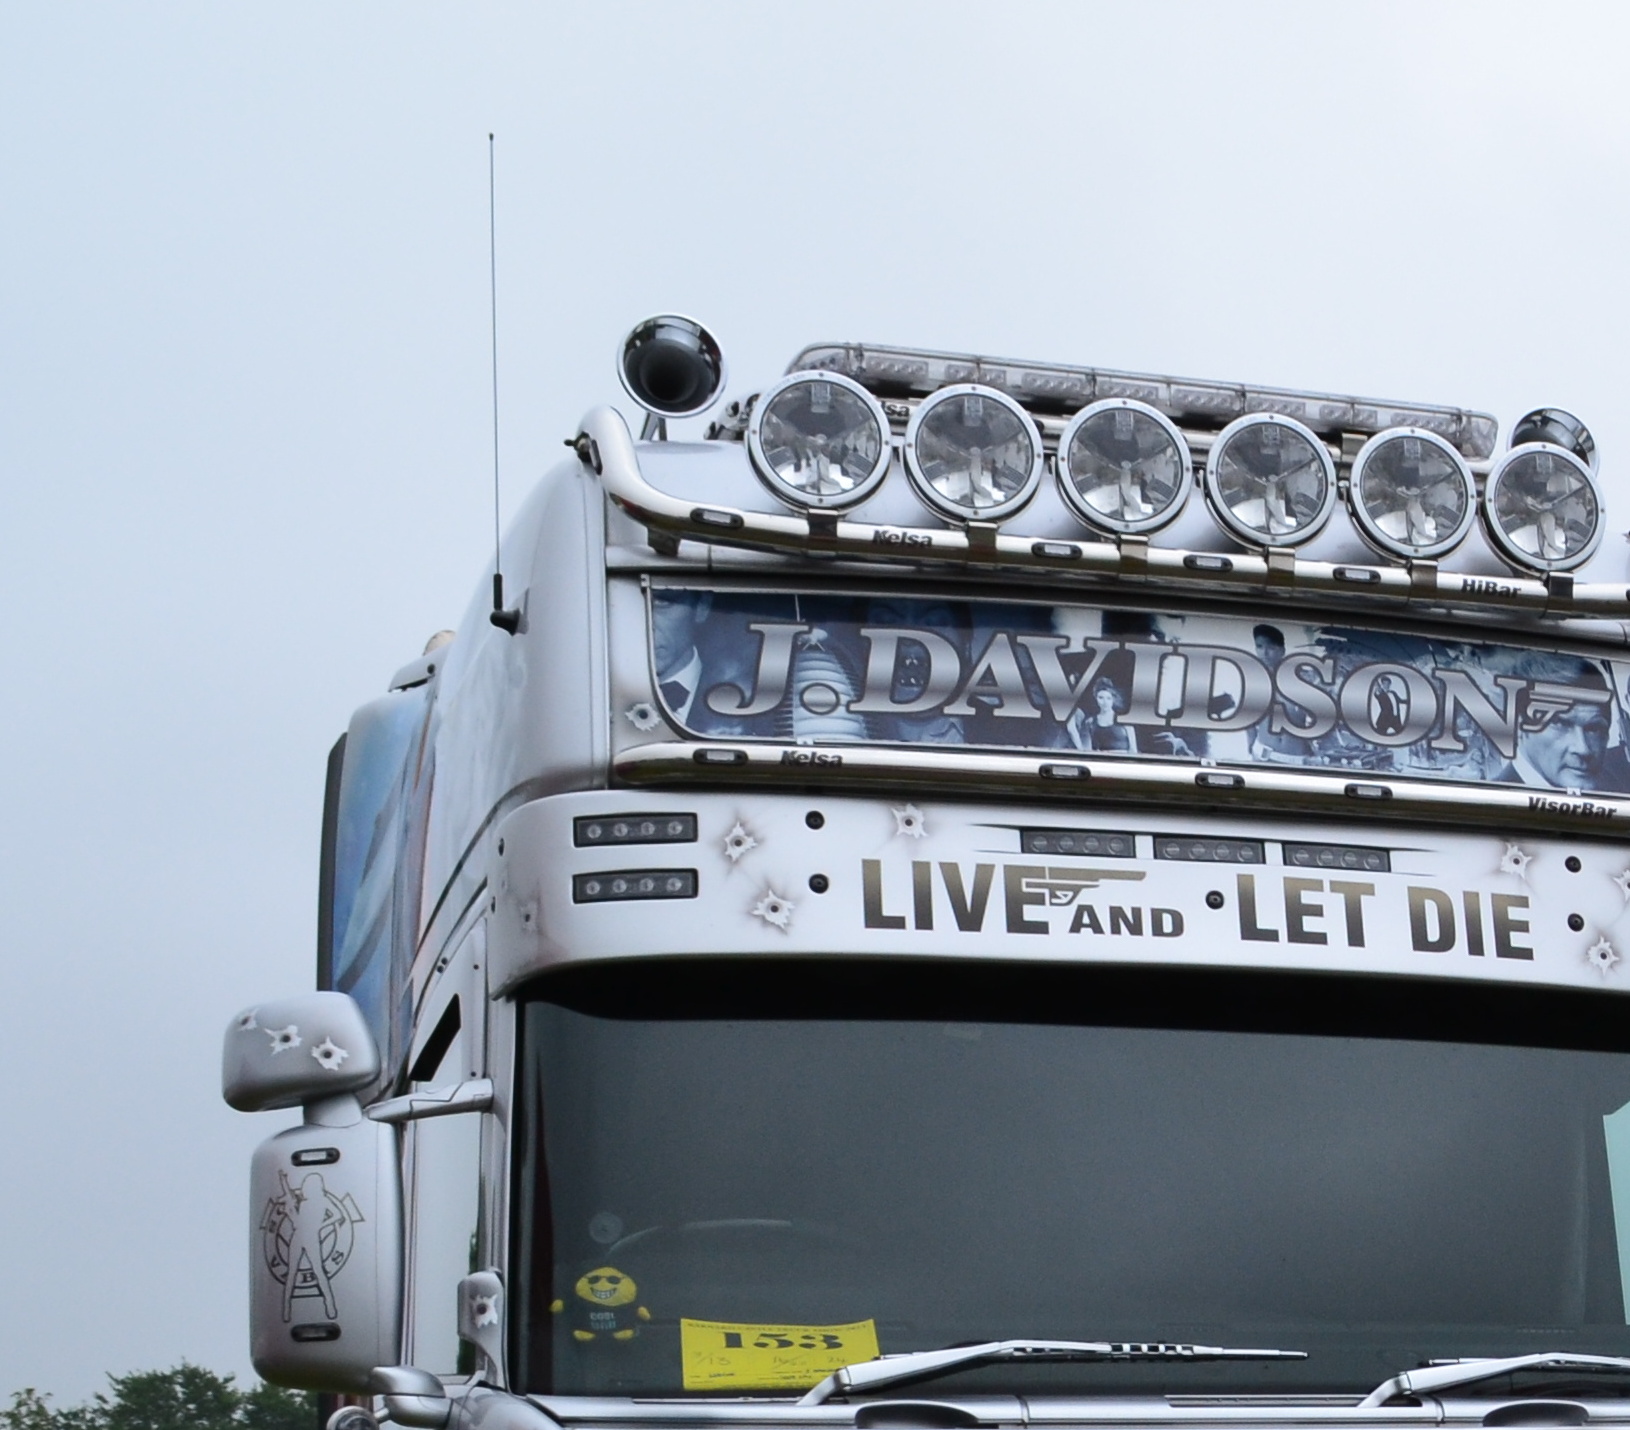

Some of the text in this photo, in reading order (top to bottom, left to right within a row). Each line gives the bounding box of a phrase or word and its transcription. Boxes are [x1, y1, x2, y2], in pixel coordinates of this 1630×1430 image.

[872, 529, 934, 548] Kelsa
[1461, 577, 1522, 599] HiBar
[781, 748, 844, 768] Kelsa
[1527, 796, 1618, 821] VisorBar
[861, 858, 1535, 961] LIVE AND LET DIE
[724, 1330, 844, 1350] 153
